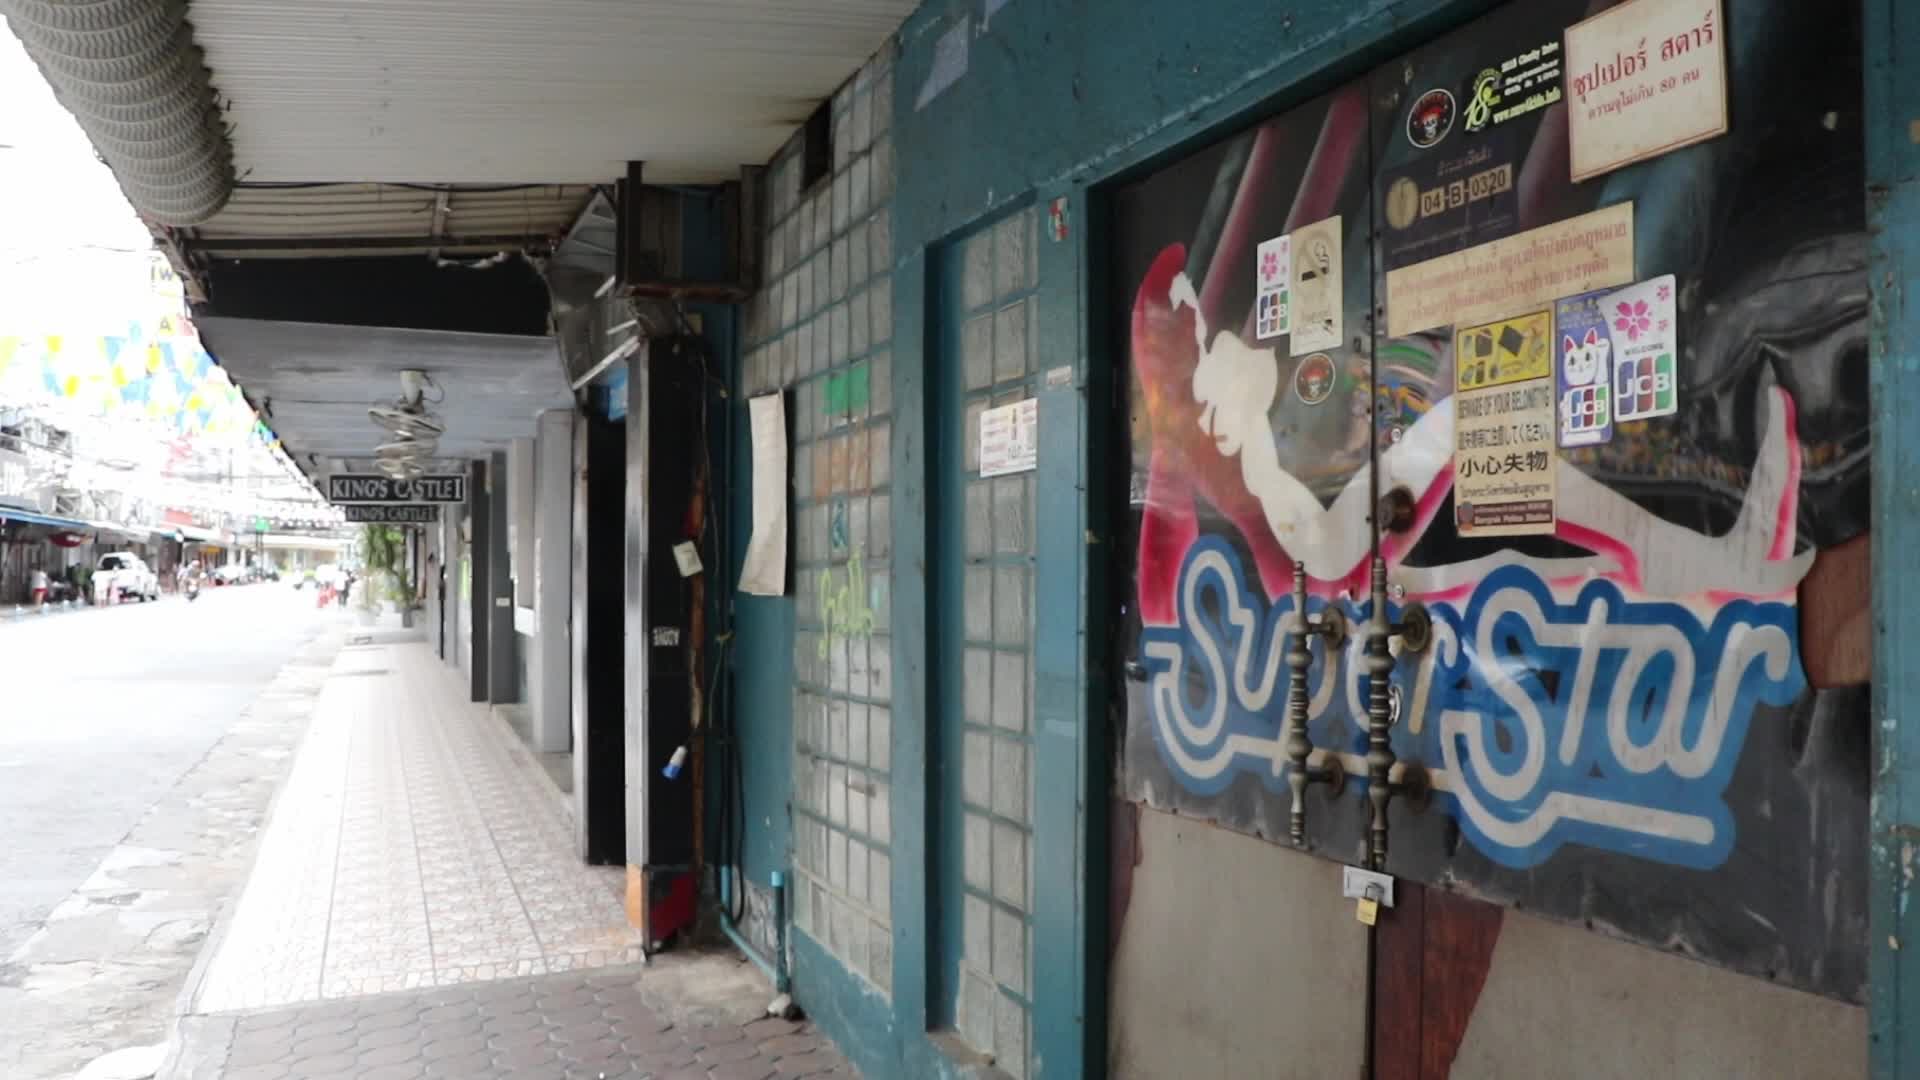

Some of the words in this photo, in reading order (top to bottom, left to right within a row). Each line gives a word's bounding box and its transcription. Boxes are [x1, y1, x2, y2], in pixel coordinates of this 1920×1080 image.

[1460, 451, 1548, 478] 小心失物
[331, 479, 388, 499] KING'S
[1439, 586, 1792, 848] Star
